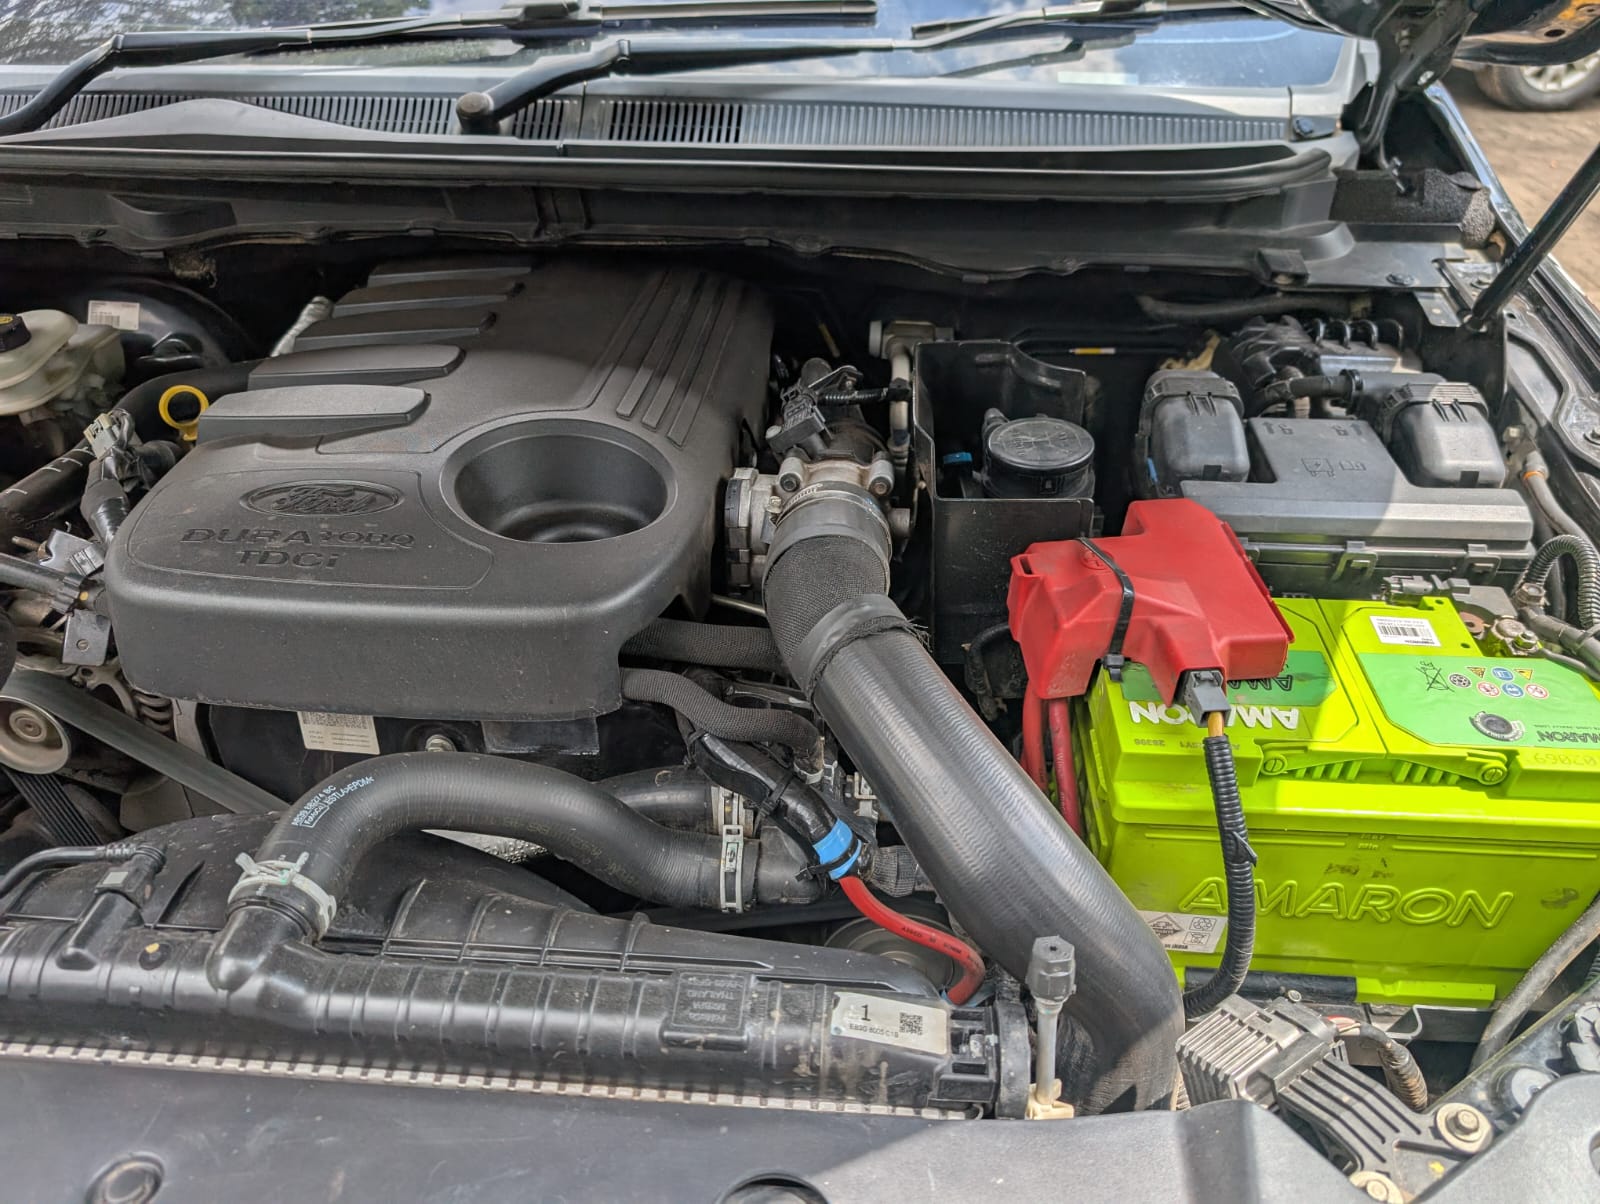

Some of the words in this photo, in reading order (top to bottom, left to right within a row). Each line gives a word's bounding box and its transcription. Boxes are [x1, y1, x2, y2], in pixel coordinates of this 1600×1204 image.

[271, 485, 376, 515] Ford
[237, 550, 340, 569] TDCi
[1128, 701, 1300, 730] AMON
[1178, 876, 1514, 929] AMARON
[860, 1004, 872, 1022] 1
